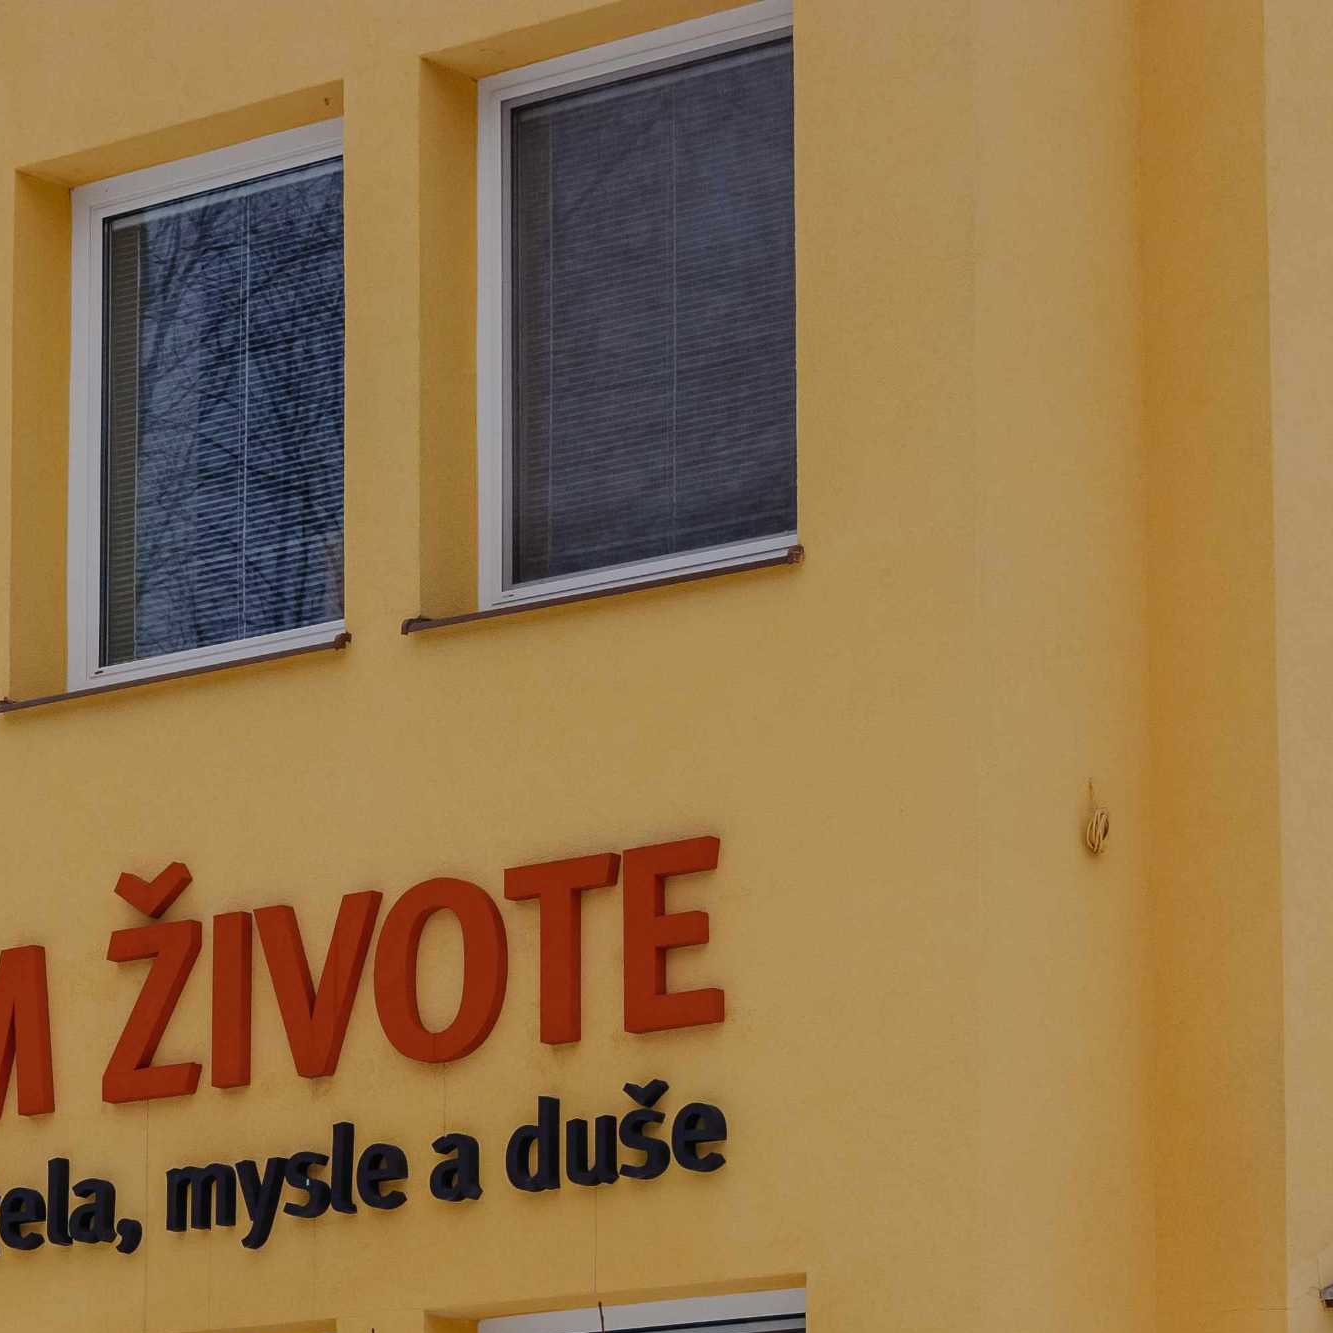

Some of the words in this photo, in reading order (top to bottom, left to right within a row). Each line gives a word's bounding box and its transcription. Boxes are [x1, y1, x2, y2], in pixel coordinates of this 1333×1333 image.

[102, 836, 725, 1104] ŽIVOTE
[166, 1121, 409, 1250] mysle
[429, 1132, 483, 1201] a
[505, 1078, 728, 1192] duše
